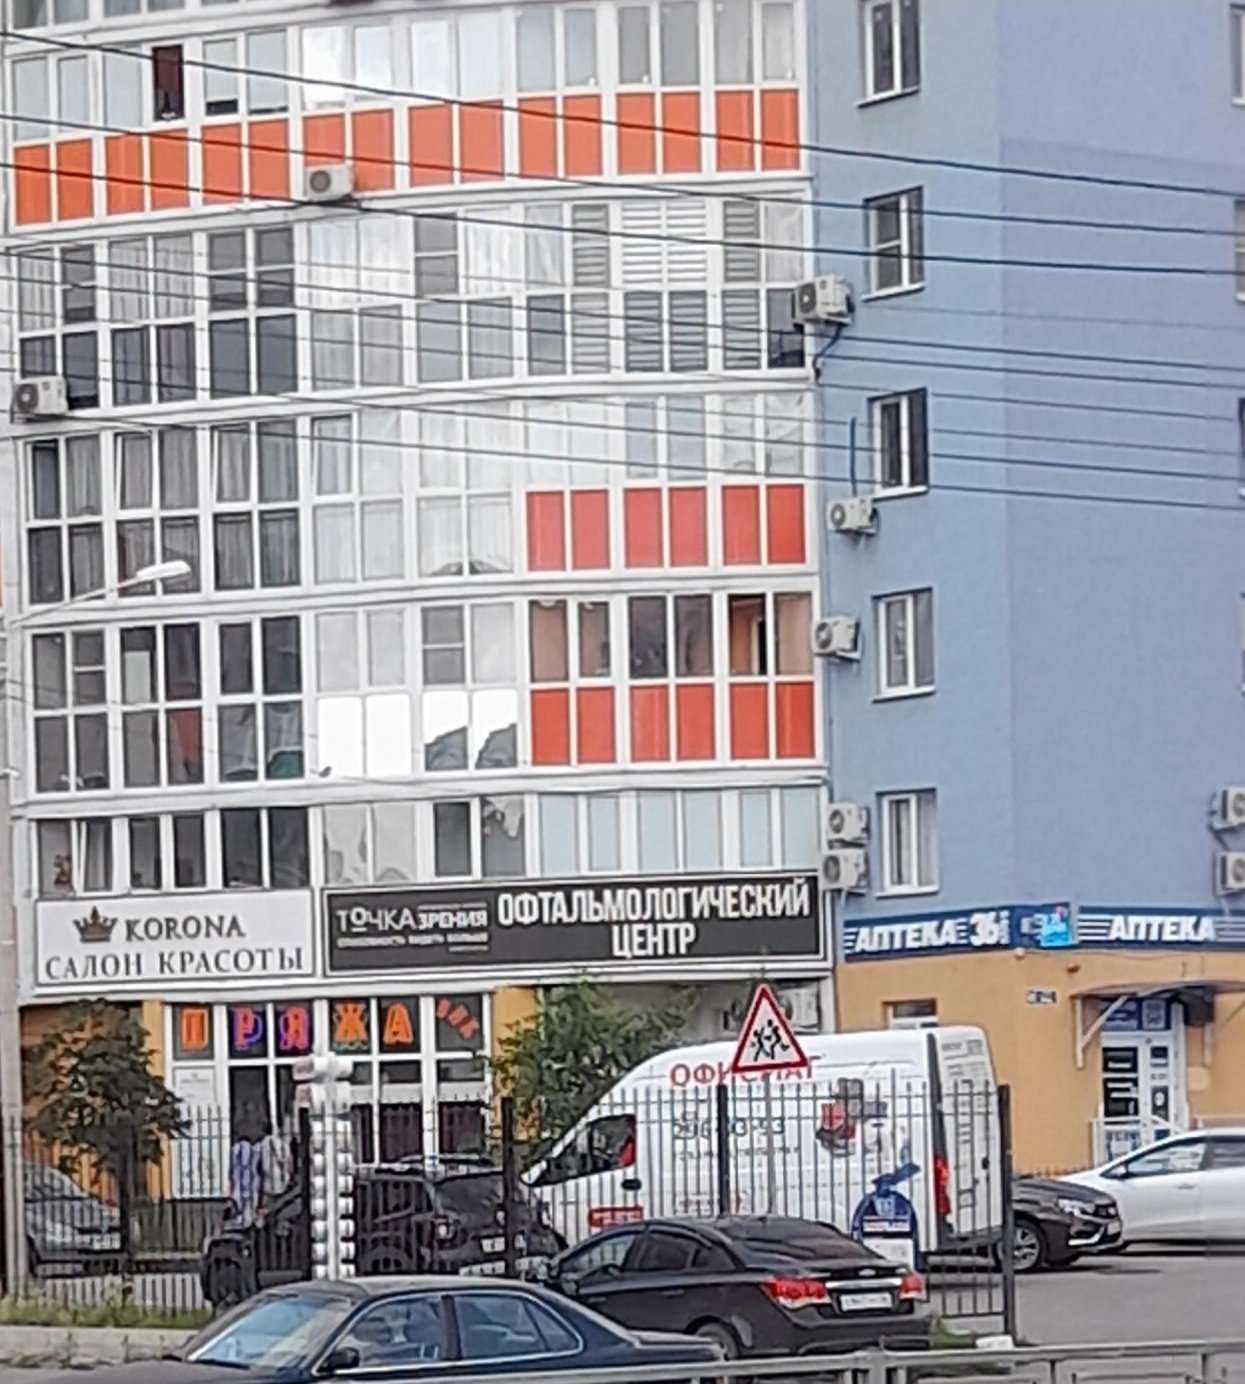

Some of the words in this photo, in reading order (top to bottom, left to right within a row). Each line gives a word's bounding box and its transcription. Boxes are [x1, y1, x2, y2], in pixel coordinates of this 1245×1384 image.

[336, 906, 417, 933] ТОЧКА
[417, 910, 488, 930] ЗРЕНИЯ
[498, 878, 811, 927] ОФТАЛЬМОЛОГИЧЕСКИЙ
[124, 914, 246, 943] KORONA
[612, 922, 696, 958] ЦЕНТР
[854, 917, 958, 953] АПТЕКА
[1108, 915, 1216, 942] АПТЕКА
[45, 952, 142, 980] САЛОН
[158, 946, 304, 976] КРАСОТЫ
[179, 1001, 415, 1052] ПРЯЖА
